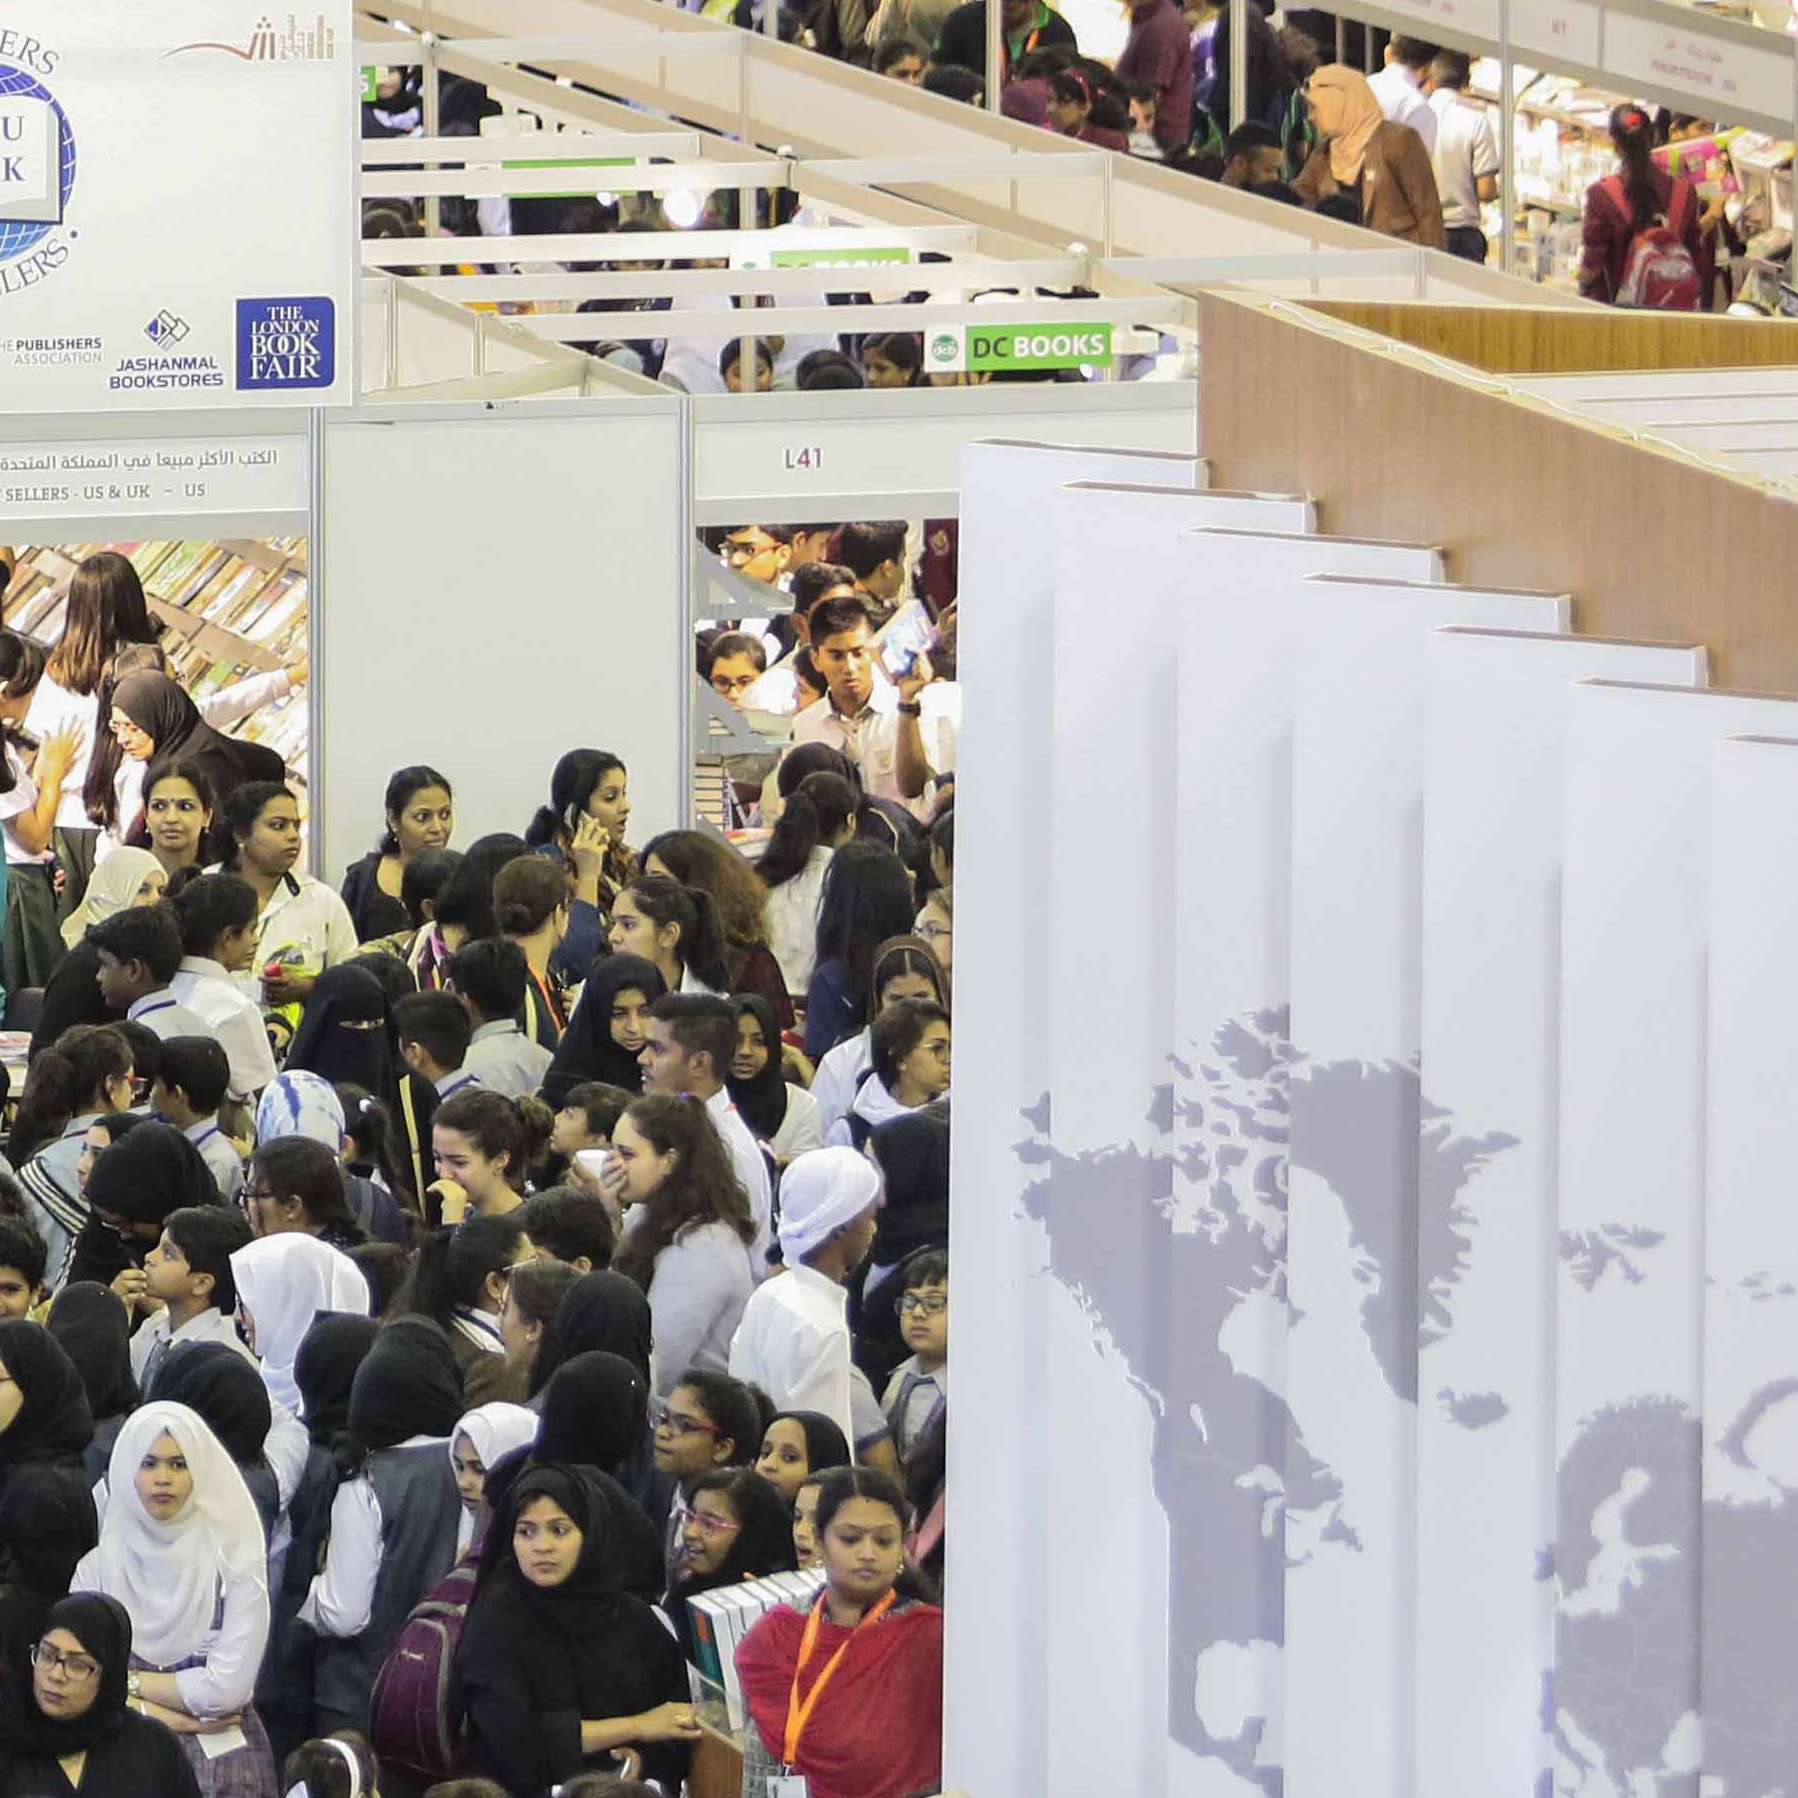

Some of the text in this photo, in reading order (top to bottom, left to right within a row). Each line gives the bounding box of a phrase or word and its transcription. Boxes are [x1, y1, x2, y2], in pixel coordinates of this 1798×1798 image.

[266, 305, 304, 321] THE
[250, 319, 320, 335] LONDON
[15, 337, 102, 352] PUBLISHERS
[249, 333, 320, 357] BOOK
[971, 333, 1105, 359] DC BOOKS
[13, 352, 102, 366] ASSOCIATION
[115, 355, 219, 373] JASHANMAL
[249, 355, 321, 380] FAIR
[109, 372, 224, 390] BOOKSTORES
[0, 455, 56, 473] المتحدة
[60, 454, 119, 471] المملكة
[123, 454, 151, 471] في
[197, 450, 235, 472] الأكثر
[238, 449, 278, 467] الكتب
[784, 446, 823, 470] L41
[5, 486, 70, 502] SELLERS
[83, 485, 104, 500] US
[107, 485, 122, 499] &
[126, 484, 151, 500] UK
[184, 483, 206, 498] US
